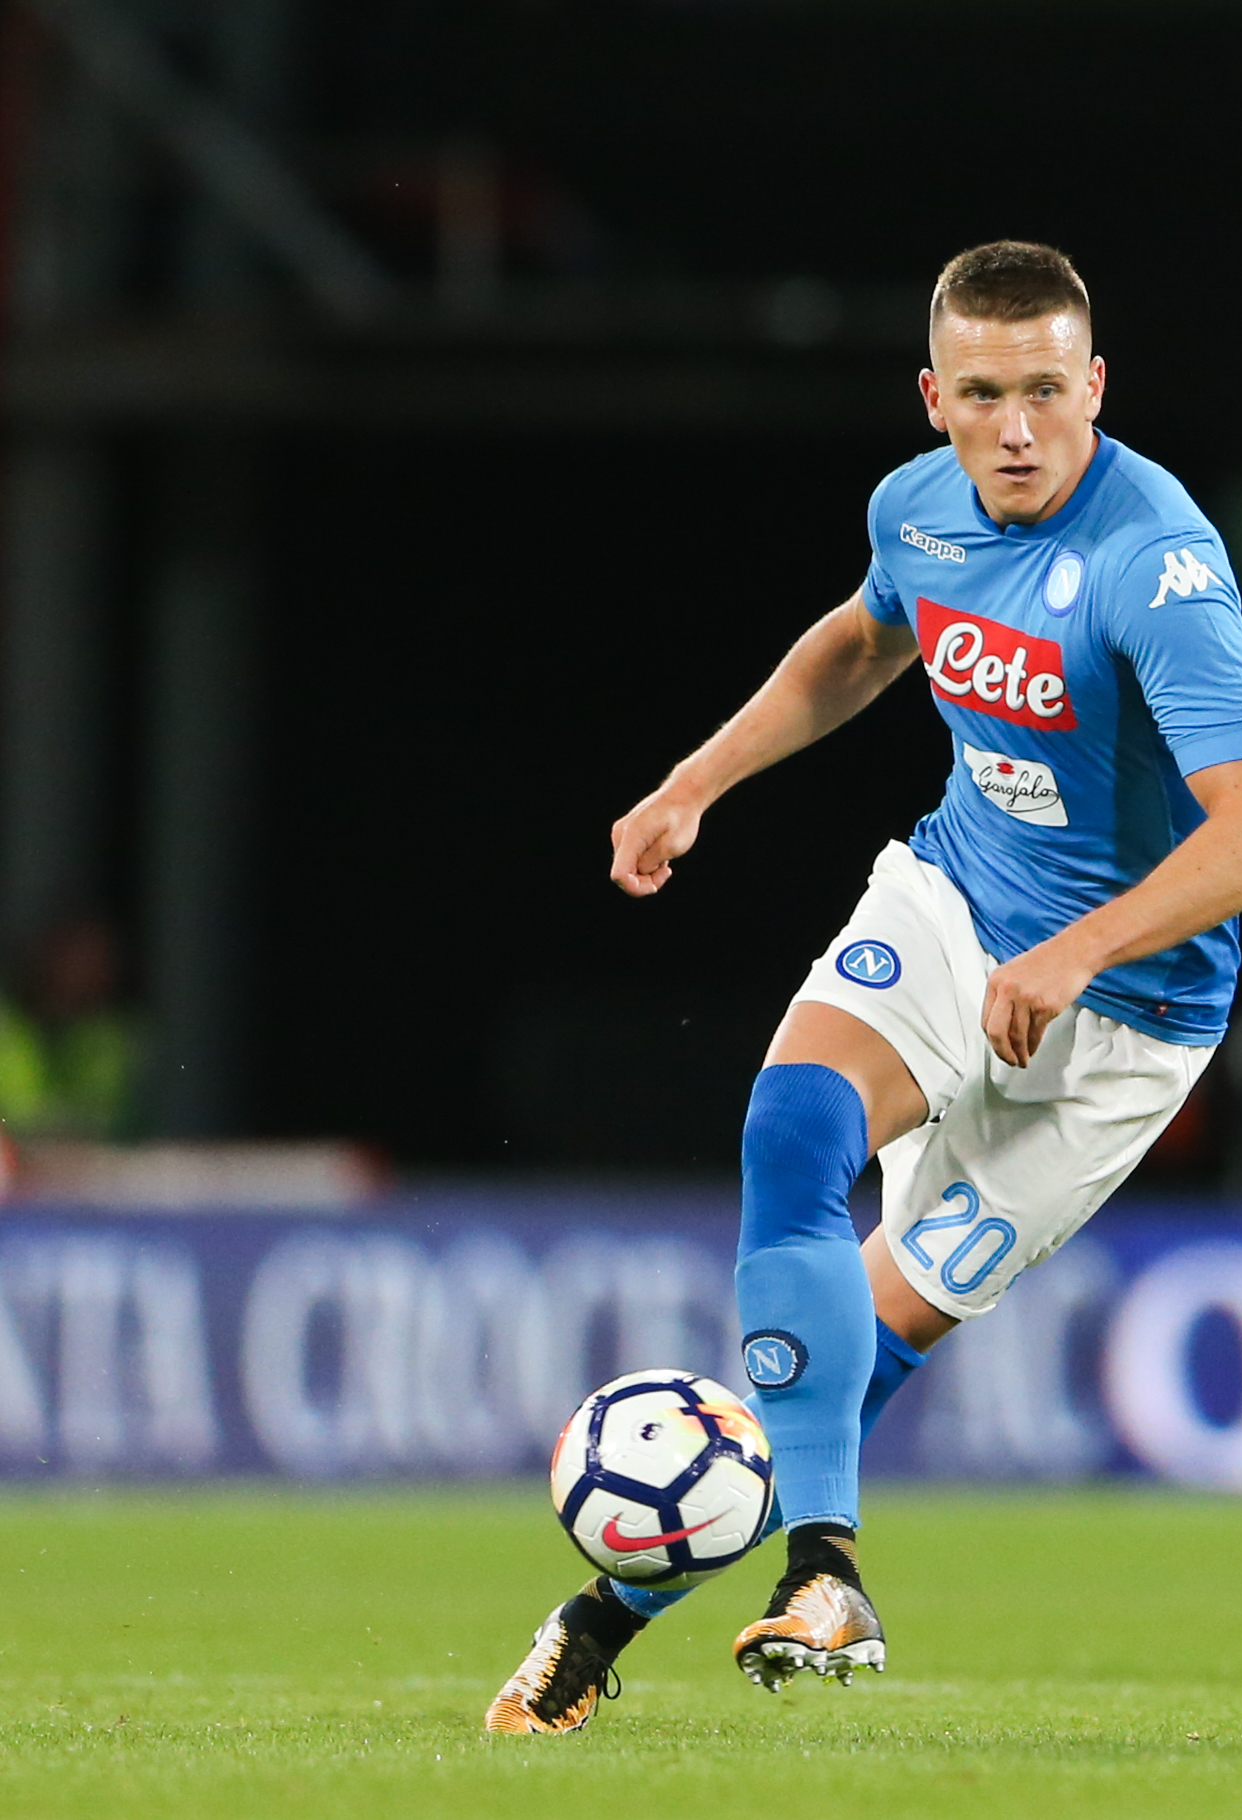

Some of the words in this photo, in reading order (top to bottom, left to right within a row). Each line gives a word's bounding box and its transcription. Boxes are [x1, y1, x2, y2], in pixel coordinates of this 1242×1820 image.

[900, 523, 966, 564] Kappa
[1052, 567, 1078, 599] N
[923, 621, 1065, 718] Lete
[979, 765, 1060, 813] Garofalo
[848, 947, 890, 977] N
[901, 1180, 1018, 1295] 20
[751, 1346, 782, 1377] N
